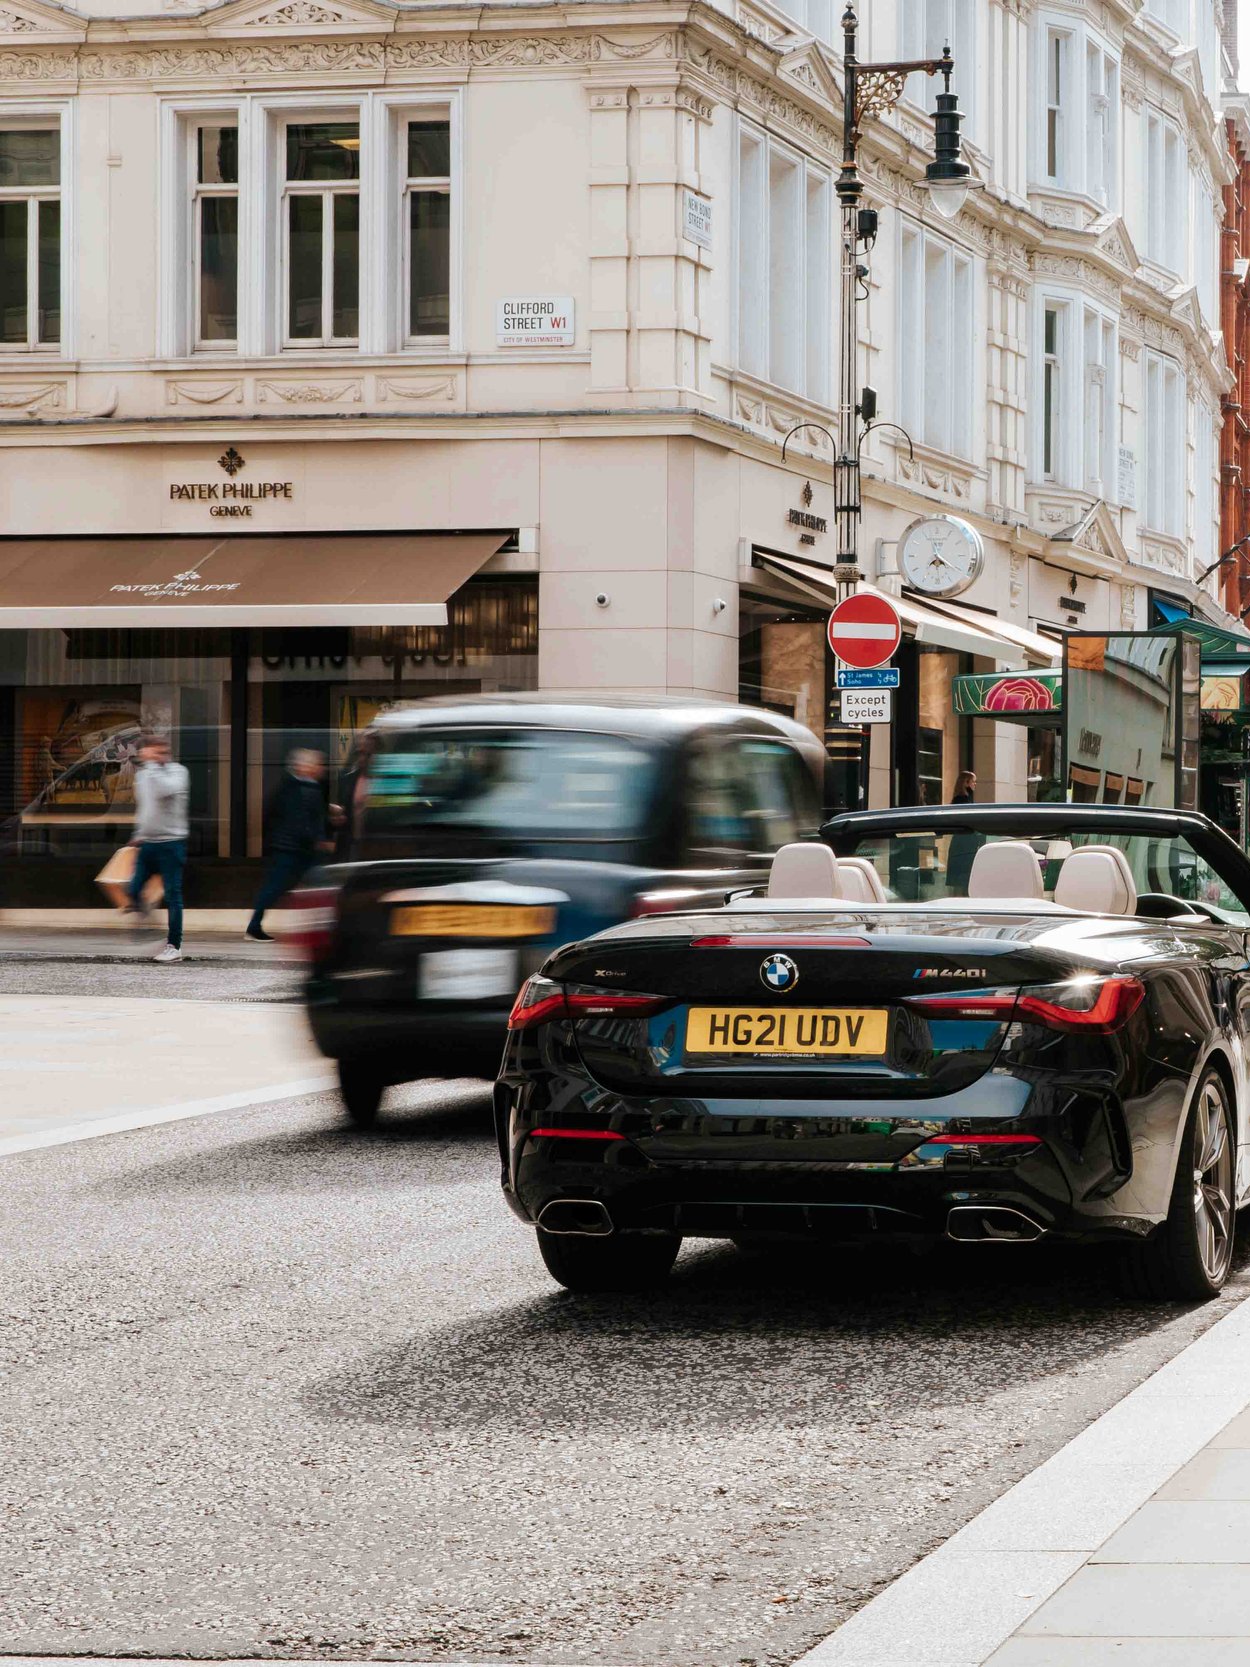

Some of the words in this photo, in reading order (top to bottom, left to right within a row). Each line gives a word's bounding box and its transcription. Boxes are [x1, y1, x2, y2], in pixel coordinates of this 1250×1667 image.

[688, 213, 703, 230] STREET
[503, 302, 554, 315] CLIFFORD
[503, 317, 543, 329] STREET
[550, 316, 567, 328] W1
[169, 483, 219, 500] PATEK
[222, 482, 293, 499] PHILIPPE
[209, 505, 253, 517] GENEVE
[109, 584, 162, 592] PATEK
[163, 582, 241, 592] PHILIPPE
[846, 695, 886, 706] Except
[848, 708, 884, 718] cycles
[763, 956, 793, 969] BMW
[709, 1014, 786, 1046] HG21
[796, 1014, 865, 1047] UDV
